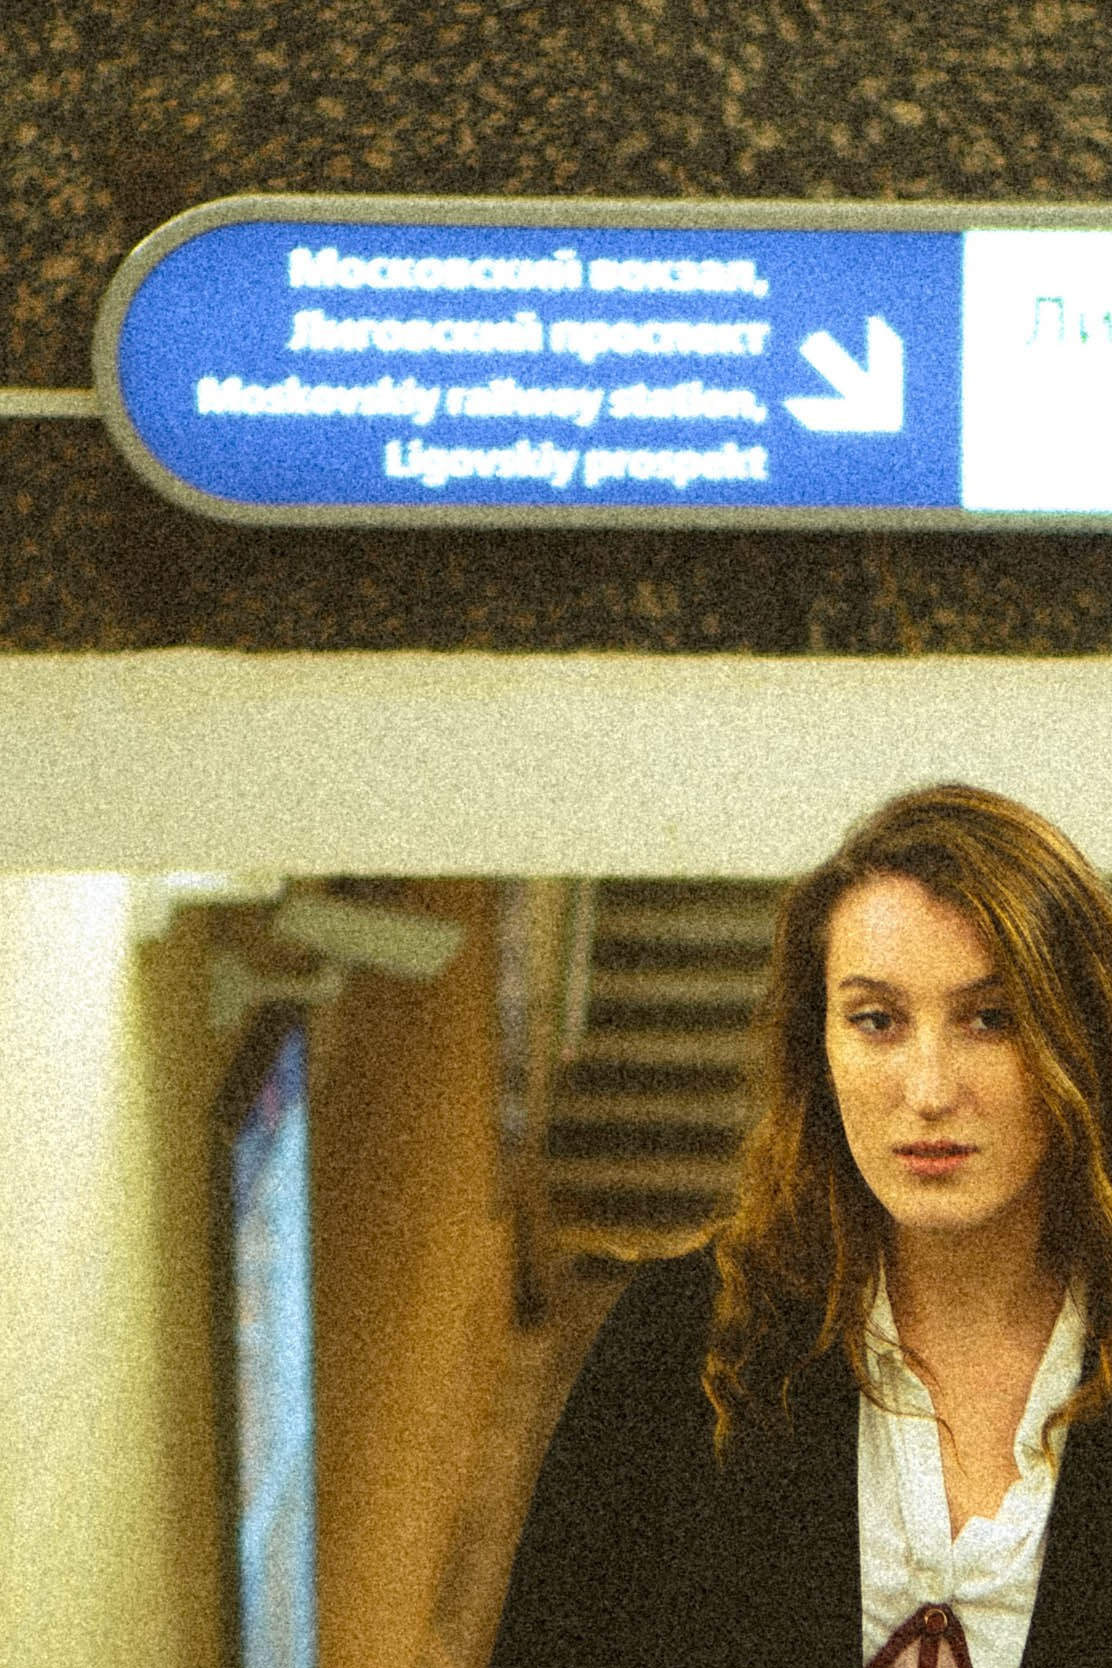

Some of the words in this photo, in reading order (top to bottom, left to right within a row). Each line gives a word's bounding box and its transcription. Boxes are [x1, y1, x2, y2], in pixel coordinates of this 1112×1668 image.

[289, 247, 583, 291] Московский
[589, 258, 769, 298] вокзал,
[287, 309, 544, 353] Лиговский
[550, 320, 771, 364] проспект
[197, 375, 441, 426] Moskovskiy
[446, 377, 605, 427] railway
[608, 380, 767, 425] station,
[385, 439, 579, 487] Ligovskiy
[583, 441, 769, 488] prospekt
